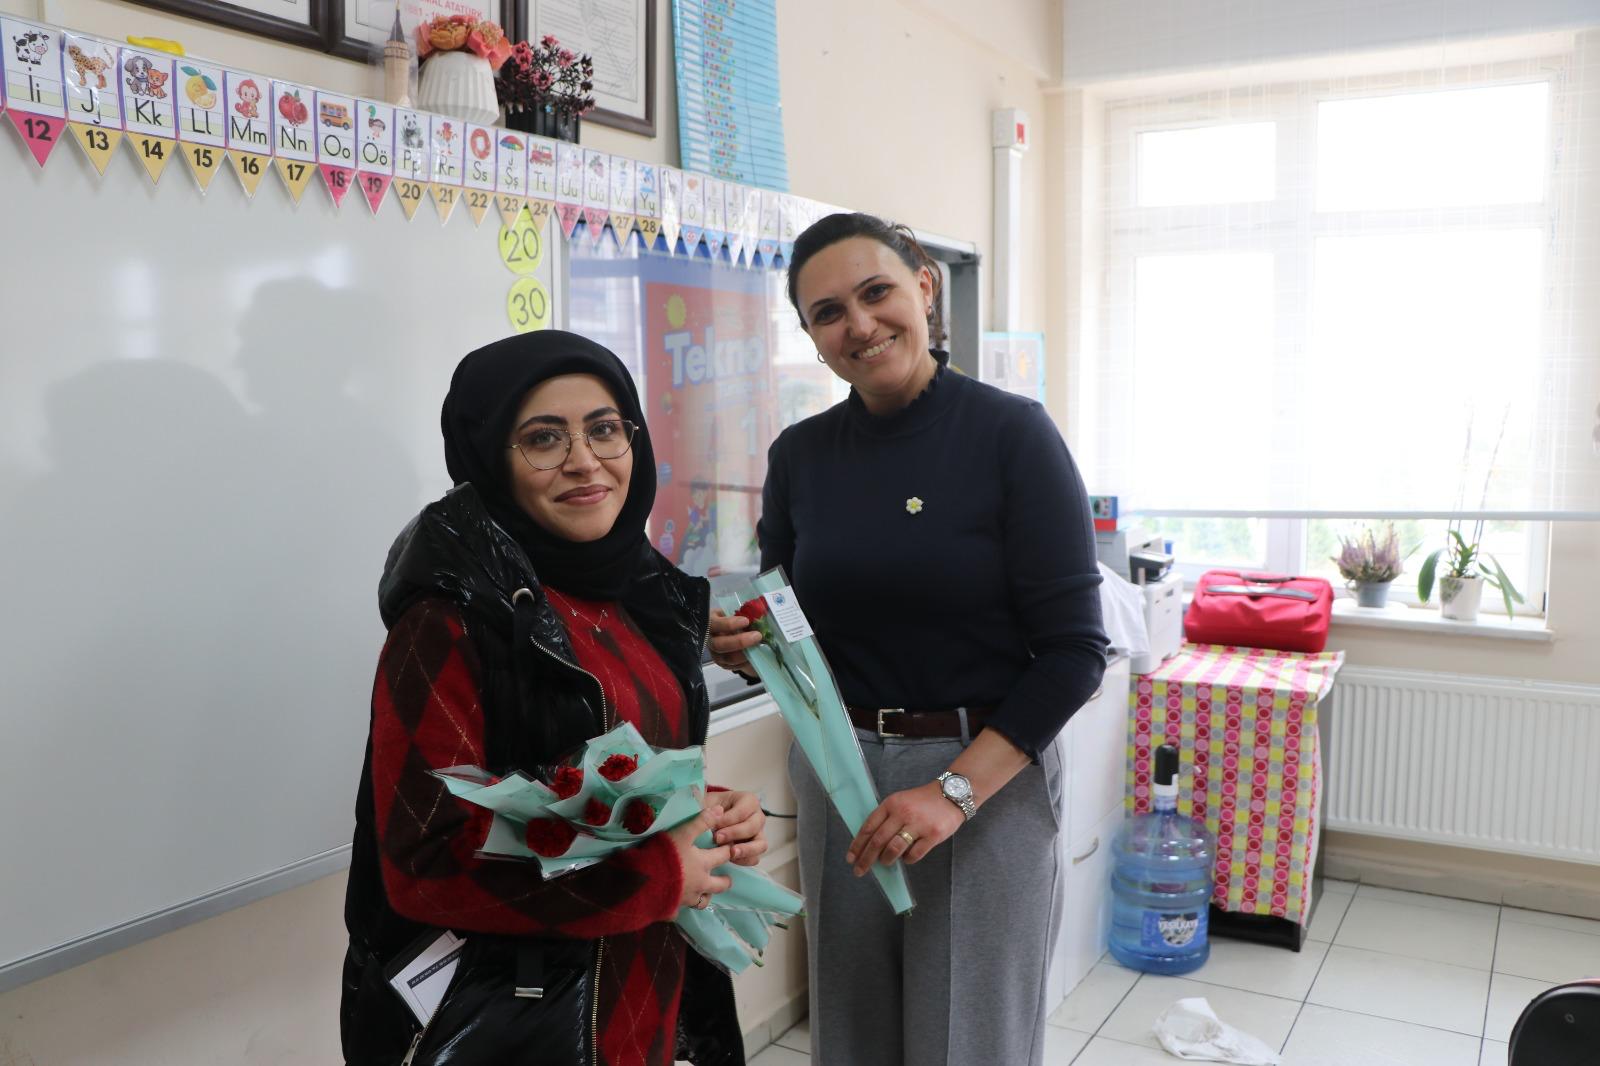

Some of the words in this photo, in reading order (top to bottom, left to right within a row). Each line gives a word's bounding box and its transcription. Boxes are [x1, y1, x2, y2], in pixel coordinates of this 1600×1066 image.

[24, 118, 52, 142] 12
[86, 129, 110, 152] 13
[141, 139, 164, 160] 14
[193, 148, 213, 168] 15
[241, 156, 260, 175] 16
[287, 163, 305, 181] 17
[330, 170, 346, 188] 18
[367, 176, 383, 193] 19
[401, 182, 421, 200] 20
[439, 187, 453, 204] 21
[470, 192, 488, 208] 22
[504, 197, 519, 213] 23
[533, 201, 548, 216] 24
[563, 206, 578, 221] 25
[615, 215, 630, 229] 27
[642, 219, 657, 234] 28
[135, 98, 162, 126] Kk
[191, 108, 212, 135] Ll
[231, 116, 267, 145] Mm
[281, 125, 307, 152] Nn
[324, 134, 351, 159] Oo
[363, 136, 388, 165] Öö
[439, 154, 455, 176] Rr
[472, 160, 488, 182] Ss
[534, 170, 548, 192] Tt
[561, 176, 578, 198] Uu
[640, 192, 655, 217] Yy
[504, 227, 539, 263] 20
[512, 287, 546, 326] 30
[664, 324, 766, 388] Tekno
